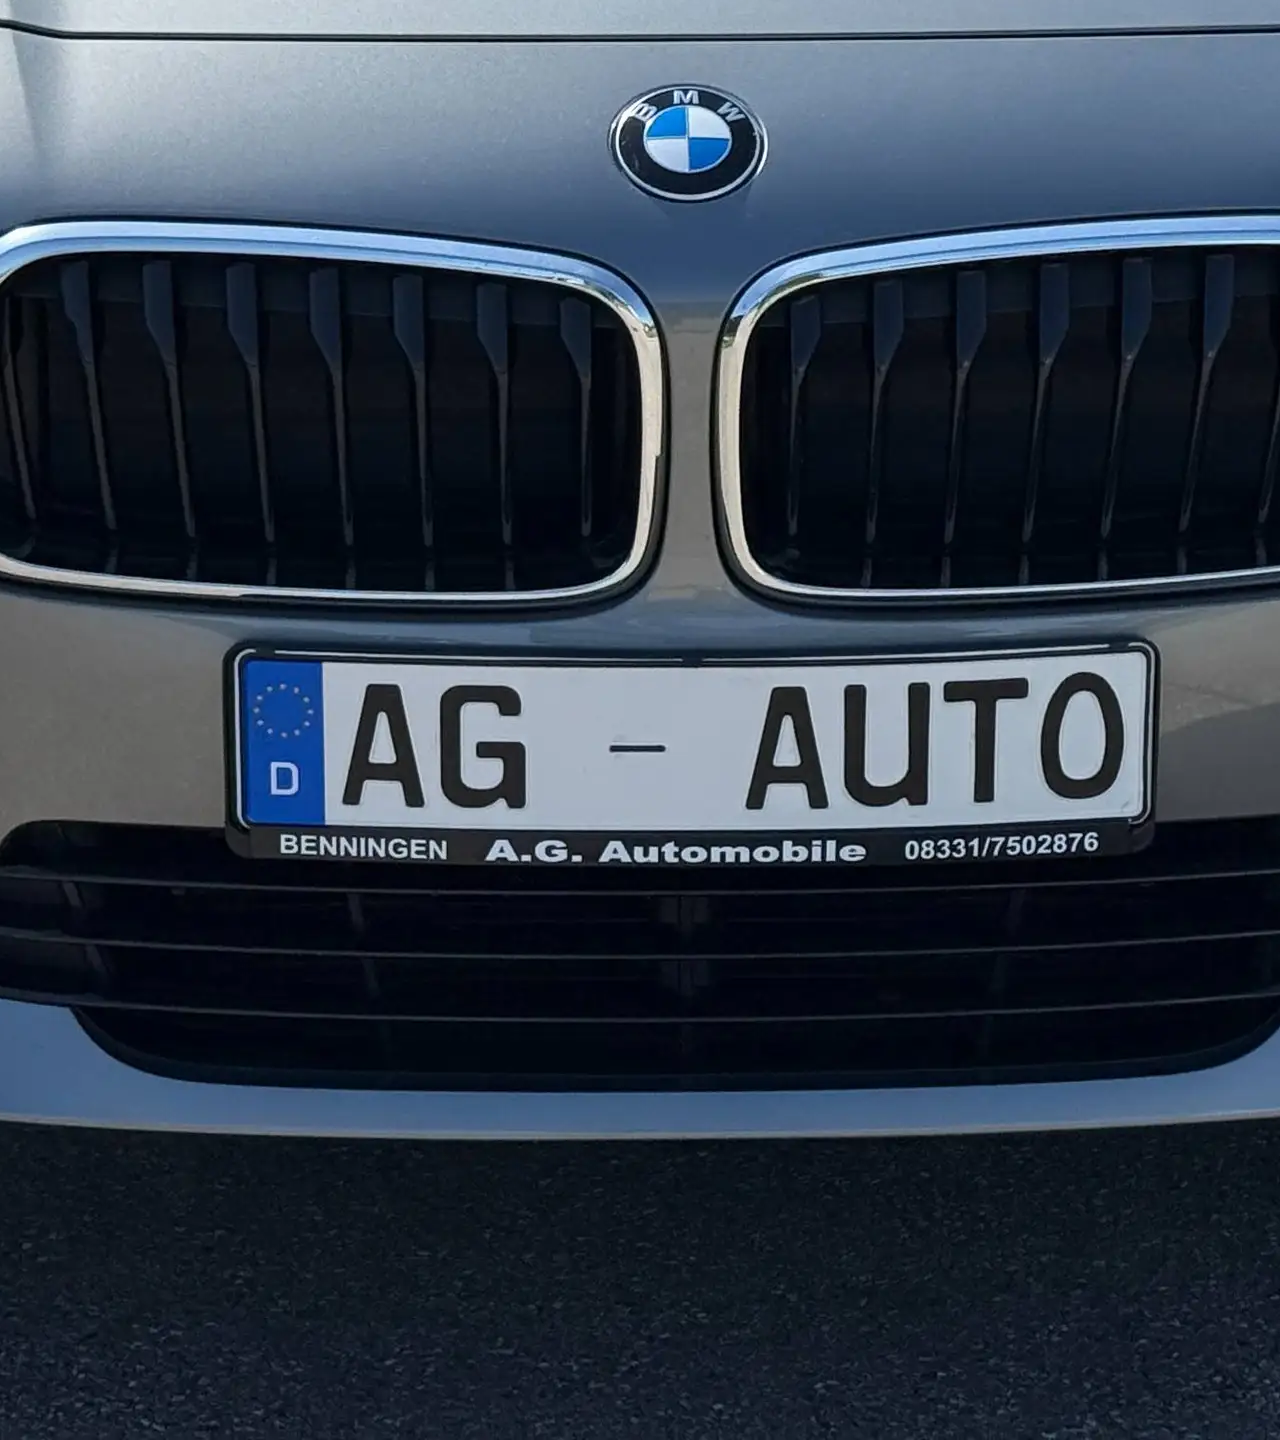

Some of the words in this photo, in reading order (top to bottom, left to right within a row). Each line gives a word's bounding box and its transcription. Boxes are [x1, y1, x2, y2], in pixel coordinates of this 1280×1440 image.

[632, 89, 746, 123] BMW
[342, 683, 527, 809] AG
[745, 672, 1125, 810] AUTO
[270, 761, 300, 796] D
[280, 833, 448, 860] BENNINGEN
[484, 839, 583, 863] A.G.
[598, 838, 867, 864] Automobile
[904, 831, 1100, 860] 08331/7502876
